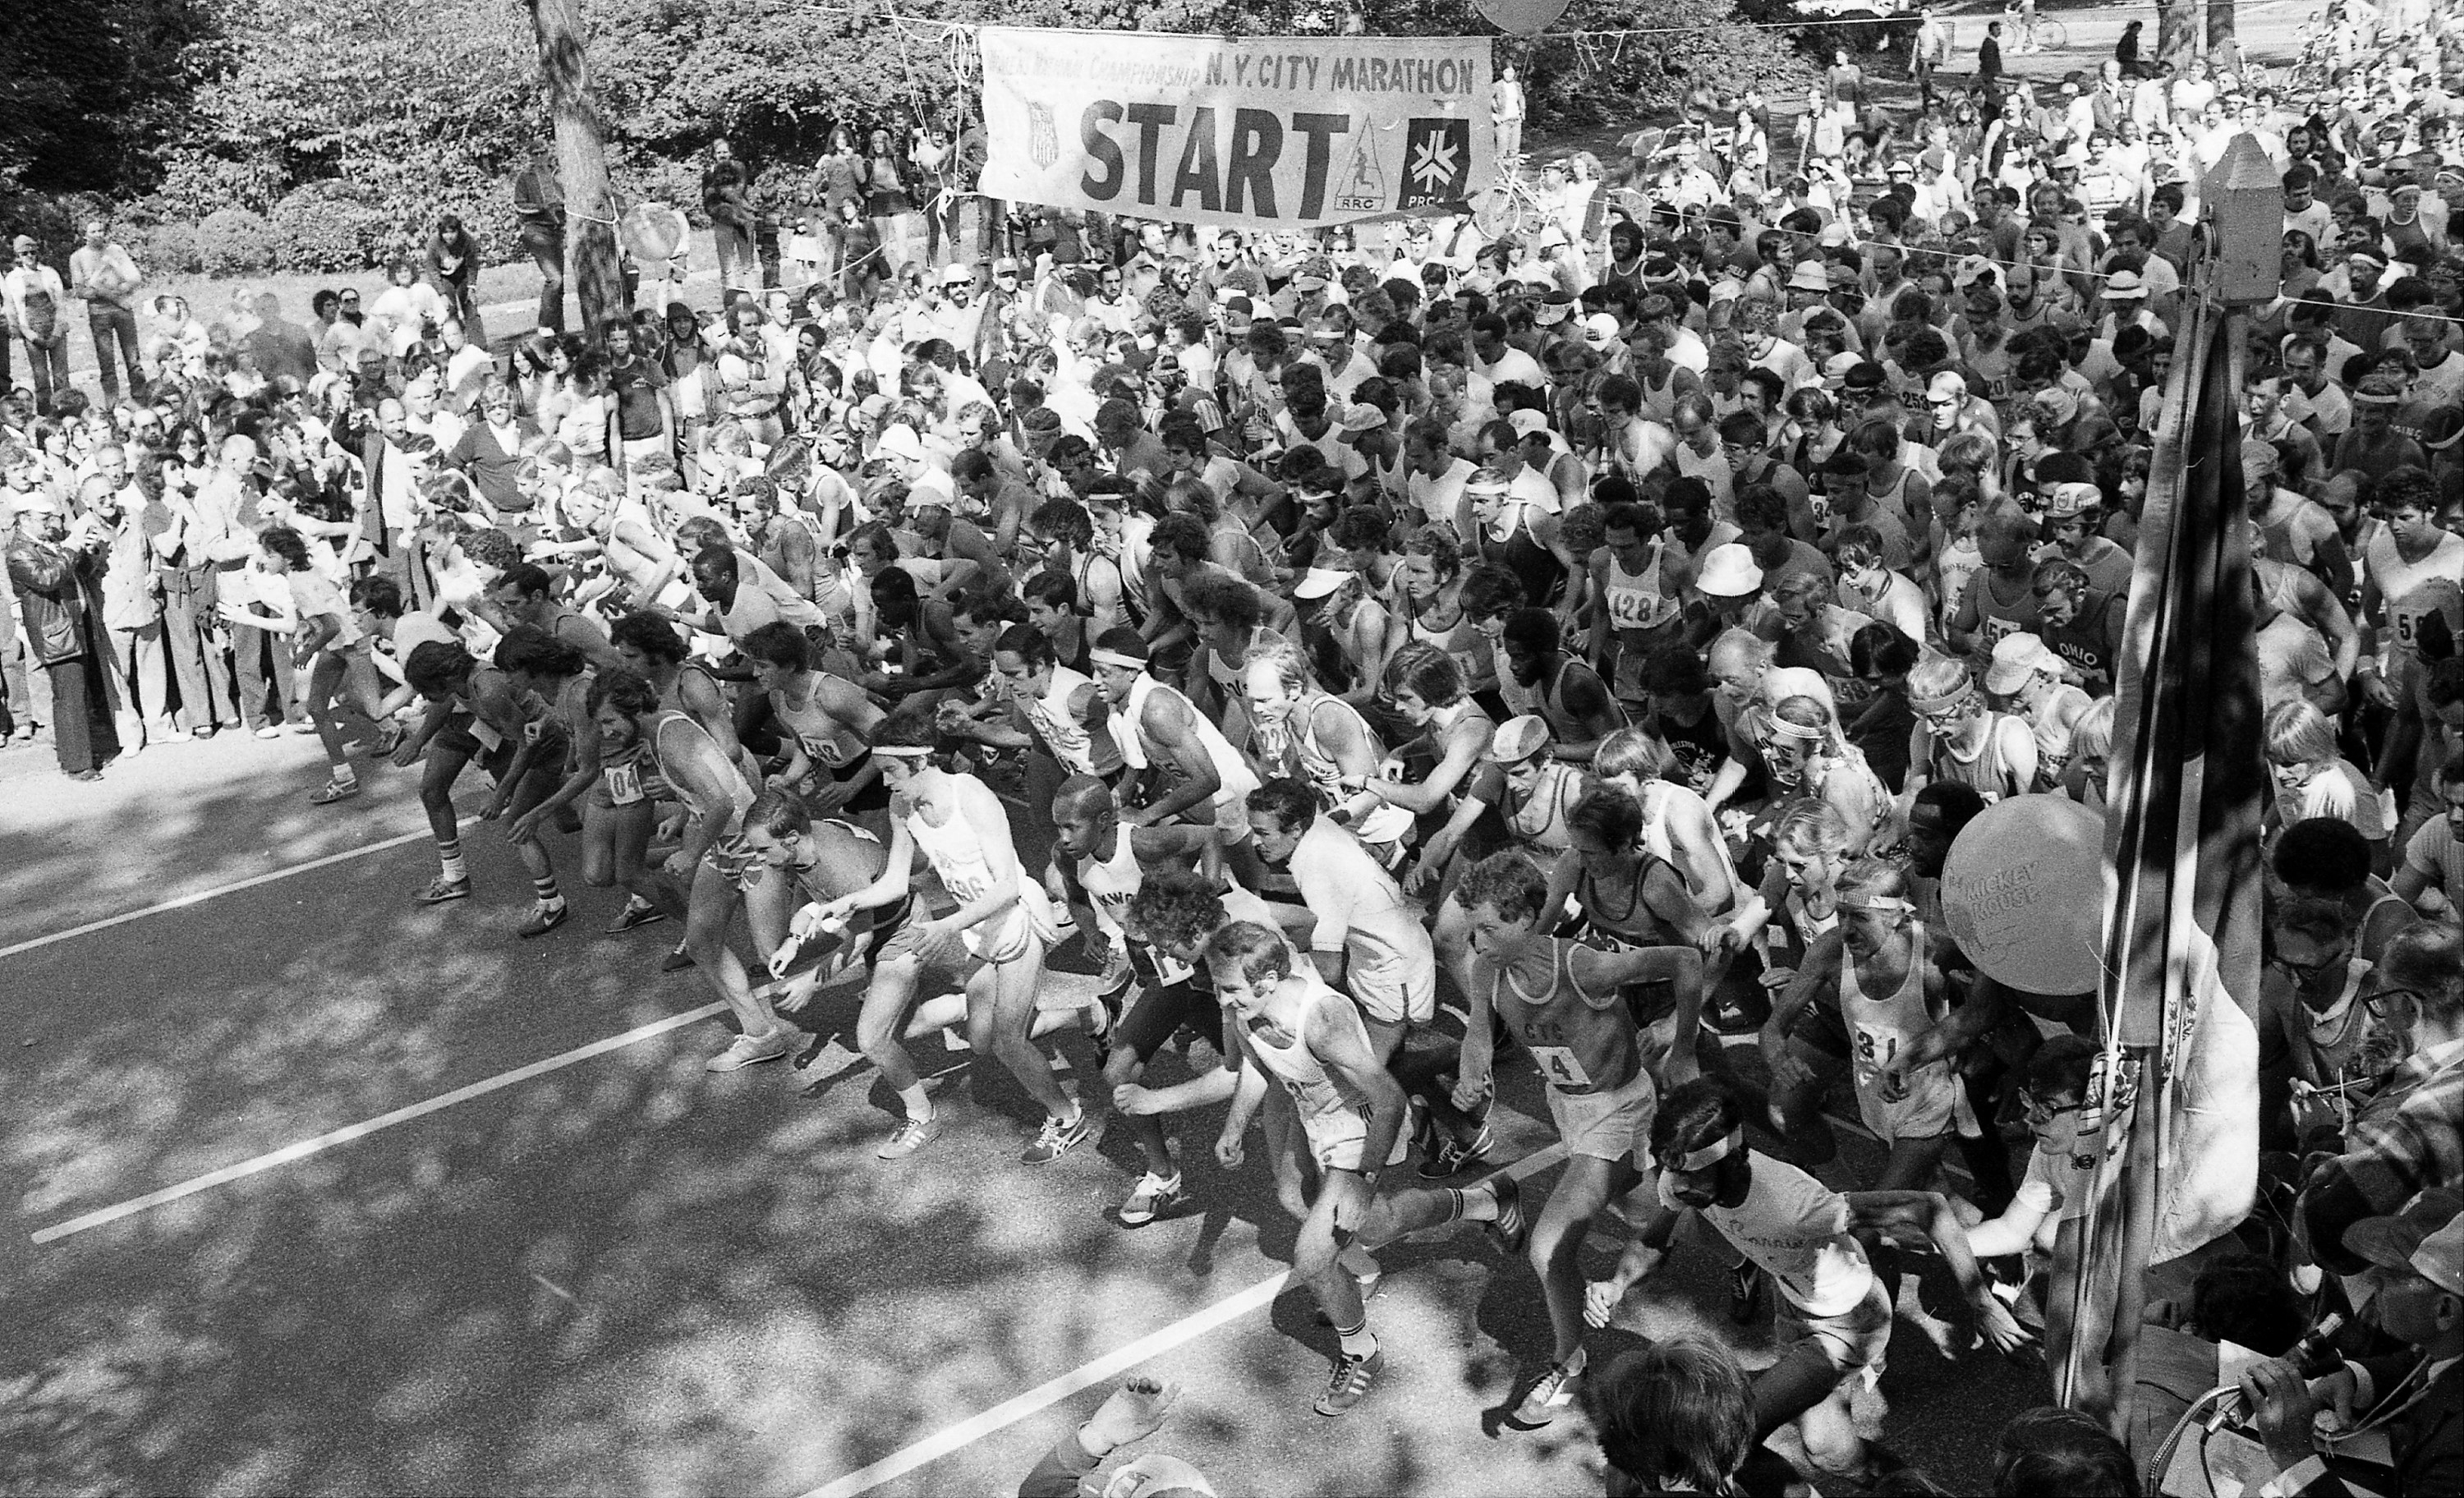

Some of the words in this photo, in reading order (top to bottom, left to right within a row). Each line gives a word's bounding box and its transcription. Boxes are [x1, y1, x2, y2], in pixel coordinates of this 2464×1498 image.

[1331, 57, 1473, 95] MARATHON
[1080, 99, 1349, 220] START
[1342, 199, 1374, 209] RRC
[2059, 642, 2098, 666] OHIO
[1965, 861, 2039, 901] MICKEY
[1971, 883, 2042, 921] MOUSE
[1524, 1023, 1562, 1041] CTC
[1551, 1055, 1573, 1081] 4
